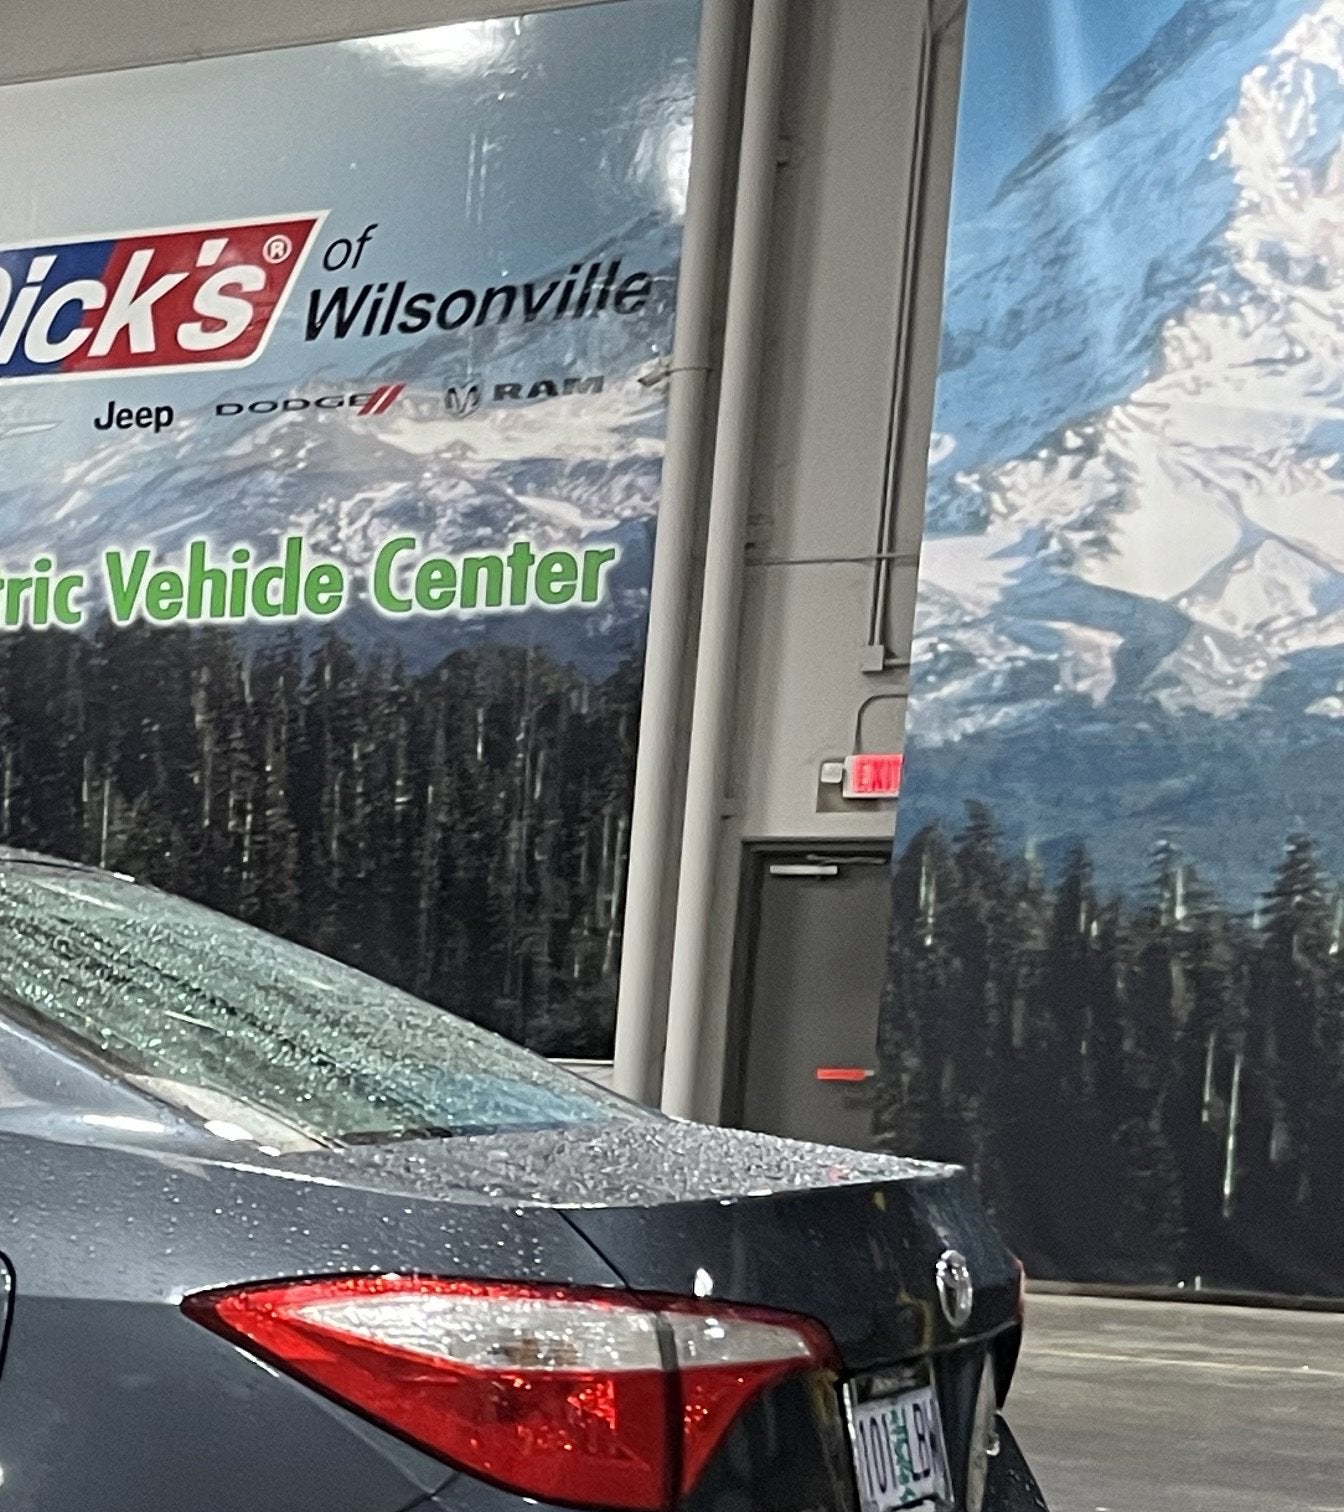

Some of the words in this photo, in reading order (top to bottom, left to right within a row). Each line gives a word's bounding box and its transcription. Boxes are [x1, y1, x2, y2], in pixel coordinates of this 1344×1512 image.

[322, 223, 379, 272] of
[305, 258, 653, 341] Wilsonville
[215, 392, 374, 417] DODGE
[493, 375, 605, 402] RAM
[94, 401, 174, 433] Jeep
[105, 536, 344, 622] Vehicle
[374, 537, 615, 613] Center
